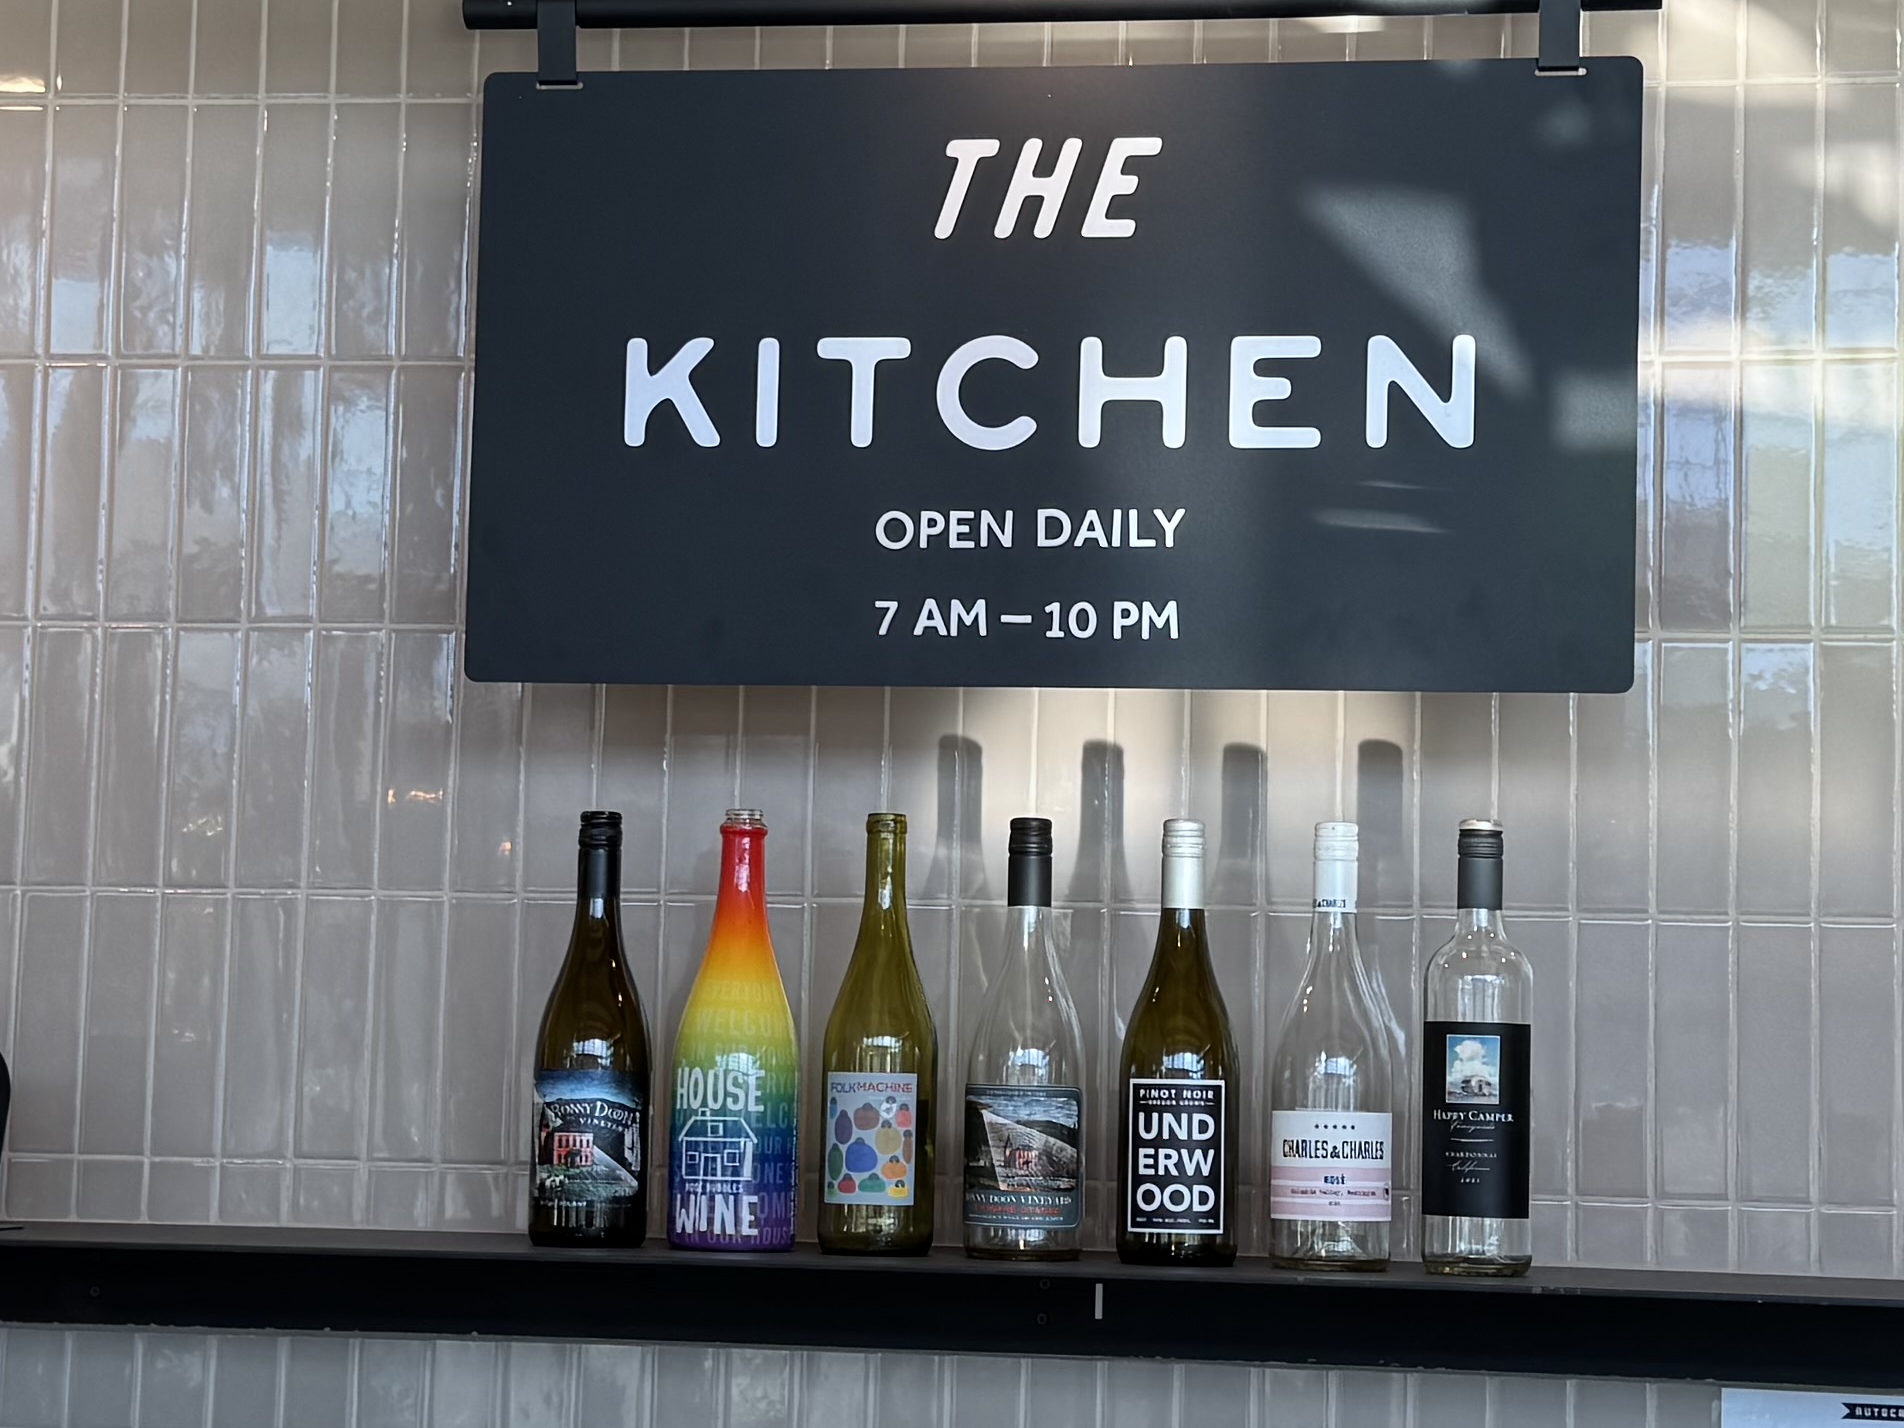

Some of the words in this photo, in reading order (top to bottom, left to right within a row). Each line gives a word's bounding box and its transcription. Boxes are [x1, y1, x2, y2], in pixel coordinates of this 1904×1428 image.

[933, 136, 1163, 240] THE
[623, 334, 1477, 451] KITCHEN
[874, 509, 1015, 551] OPEN
[1037, 508, 1187, 550] DAILY
[874, 601, 896, 637] 7
[913, 599, 988, 638] AM
[1046, 601, 1096, 639] 10
[1111, 601, 1180, 640] PM
[676, 1067, 765, 1112] HOUSE
[1140, 1089, 1176, 1098] PINOT
[1183, 1090, 1213, 1099] NOIR
[1138, 1112, 1215, 1140] UND
[1433, 1110, 1466, 1120] HAPPY
[1469, 1111, 1513, 1122] CAMPER
[1138, 1148, 1215, 1176] ERW
[676, 1194, 758, 1235] WINE
[1136, 1183, 1215, 1212] OOD
